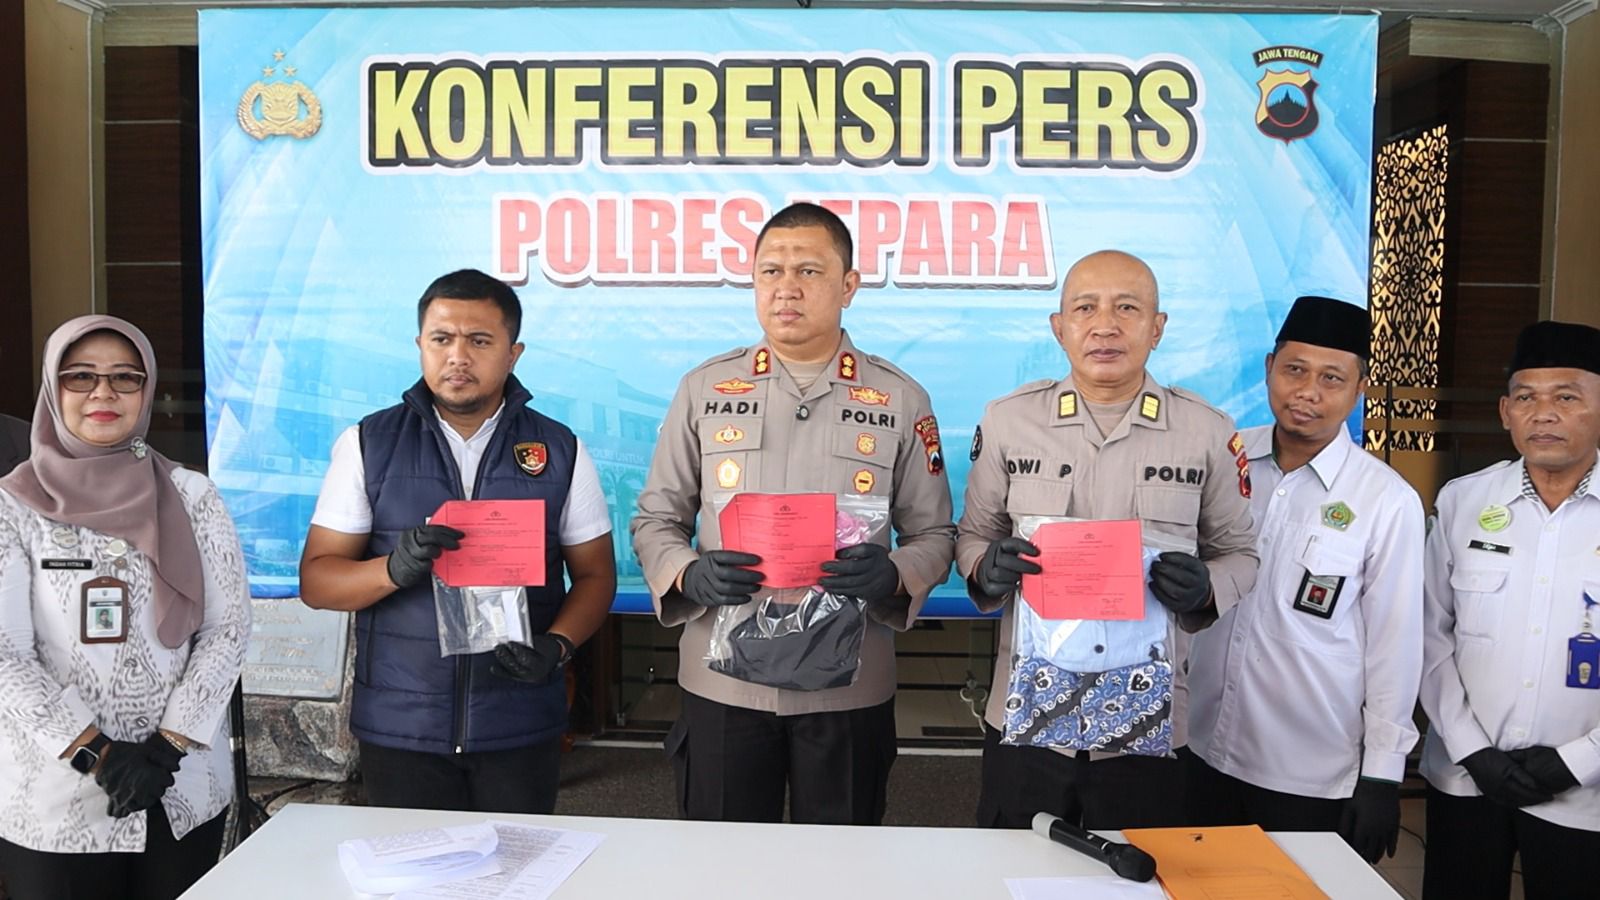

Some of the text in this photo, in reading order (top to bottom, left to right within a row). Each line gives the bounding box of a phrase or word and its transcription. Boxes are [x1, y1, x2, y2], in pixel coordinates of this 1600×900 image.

[1258, 48, 1319, 63] JAWA TENGAH
[371, 62, 1195, 166] KONFERENSI PERS
[499, 197, 1049, 277] POLRES PARA
[704, 401, 758, 416] HADI
[841, 408, 895, 429] POLRI
[1008, 459, 1072, 478] DWI P
[1144, 466, 1204, 485] POLRI
